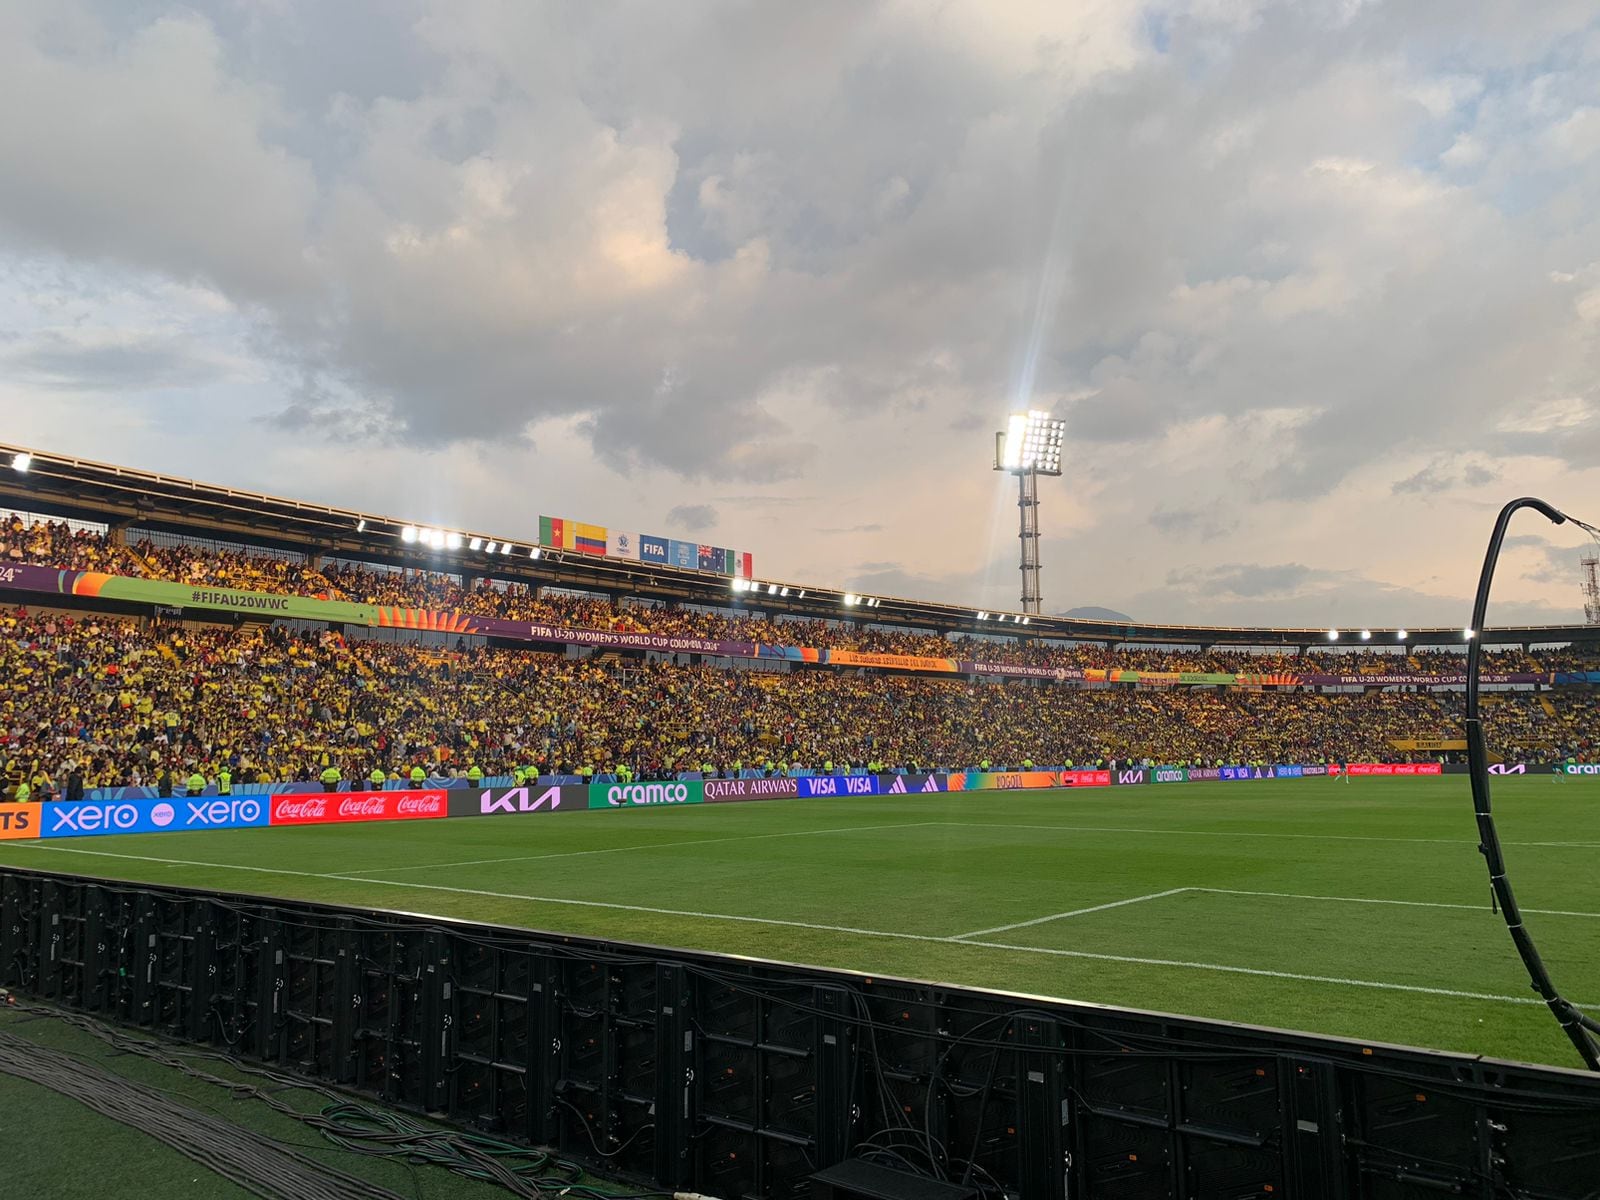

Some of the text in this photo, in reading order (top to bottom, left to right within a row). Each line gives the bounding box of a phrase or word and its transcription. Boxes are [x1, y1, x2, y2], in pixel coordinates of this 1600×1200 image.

[643, 543, 665, 556] FIFA
[192, 590, 289, 610] #FIFAU20WWC
[531, 626, 552, 638] FIFA
[554, 629, 575, 641] U-20
[576, 631, 618, 644] WOMEN'S
[619, 635, 651, 646] WORLD
[652, 637, 668, 648] CUP
[974, 663, 987, 671] FIFA
[987, 664, 1000, 673] U-20
[1000, 665, 1027, 674] WOMEN'S
[1027, 667, 1046, 676] WORLD
[1377, 675, 1411, 683] WOMEN'S
[1412, 676, 1440, 684] WORLD
[1118, 770, 1144, 784] KIA
[1156, 770, 1183, 782] aramco
[607, 783, 688, 806] aramco
[704, 778, 798, 799] QATAR AIRWAYS
[807, 777, 873, 794] VISA VISA
[480, 786, 561, 814] KIA
[52, 804, 138, 831] xero
[186, 799, 260, 825] xero
